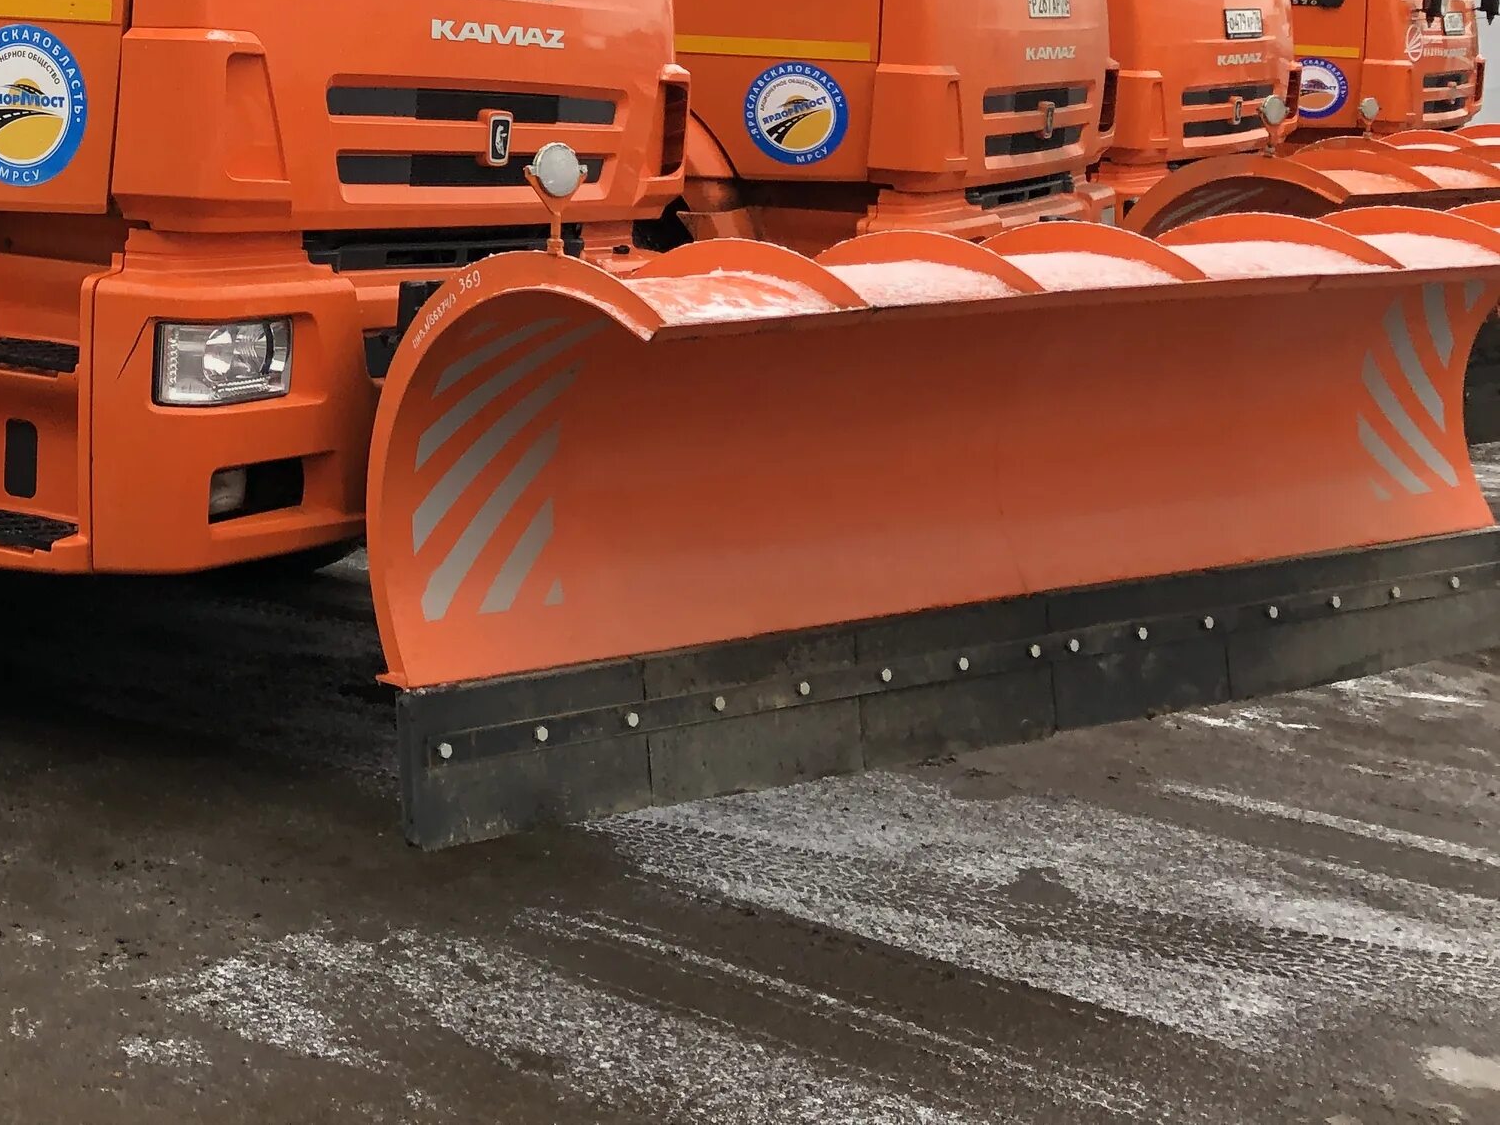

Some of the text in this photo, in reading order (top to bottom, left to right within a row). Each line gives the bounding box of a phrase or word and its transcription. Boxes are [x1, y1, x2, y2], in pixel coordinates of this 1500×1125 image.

[431, 18, 565, 49] KAMAZ
[1025, 45, 1077, 61] KAMAZ
[1217, 52, 1262, 66] KAMAZ
[27, 51, 61, 85] ОБЩЕСТВО
[796, 146, 828, 164] МРСУ
